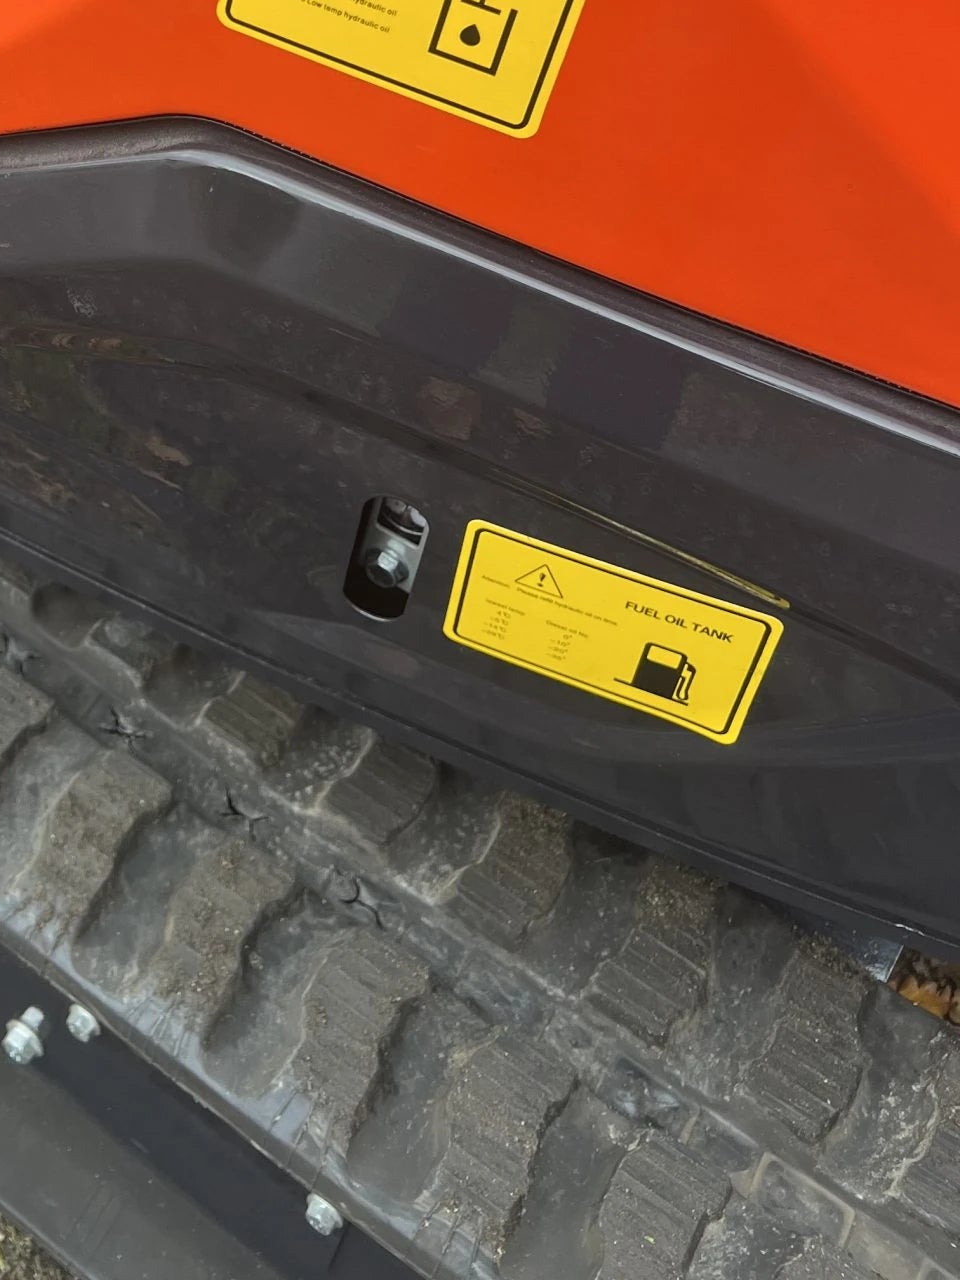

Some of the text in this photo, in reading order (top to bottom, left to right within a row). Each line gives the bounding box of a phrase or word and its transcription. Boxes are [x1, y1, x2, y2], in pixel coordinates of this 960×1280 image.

[344, 10, 379, 29] hydraulic
[625, 601, 734, 643] FUEL OIL TANK
